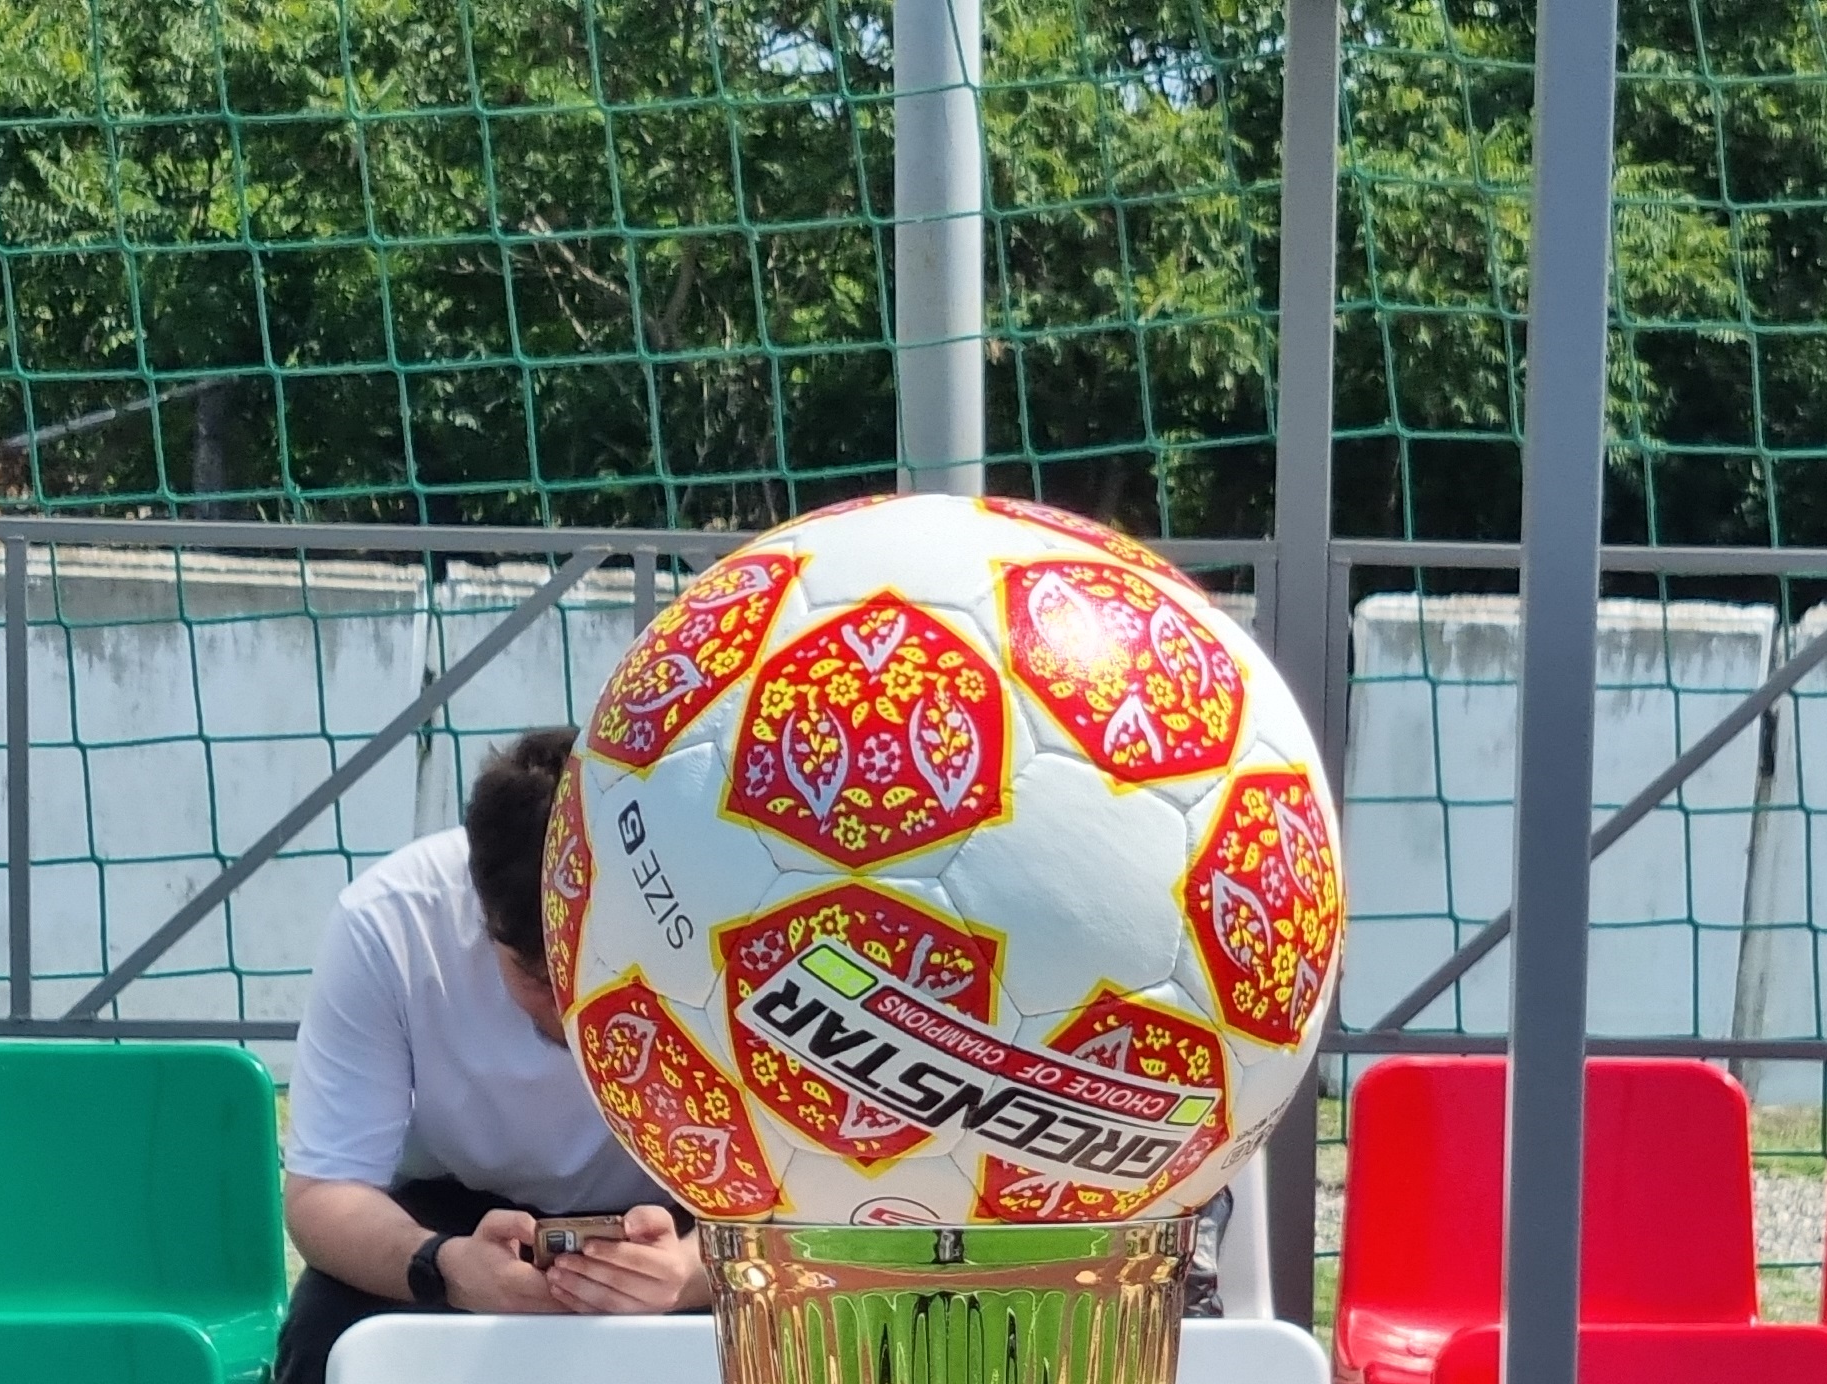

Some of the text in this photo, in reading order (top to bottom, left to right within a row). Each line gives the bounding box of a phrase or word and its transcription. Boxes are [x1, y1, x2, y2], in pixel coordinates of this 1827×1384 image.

[631, 849, 694, 950] SIZE
[751, 978, 1182, 1180] GREENSTAR
[876, 994, 1167, 1116] CHOICE OF CHAMPIONS
